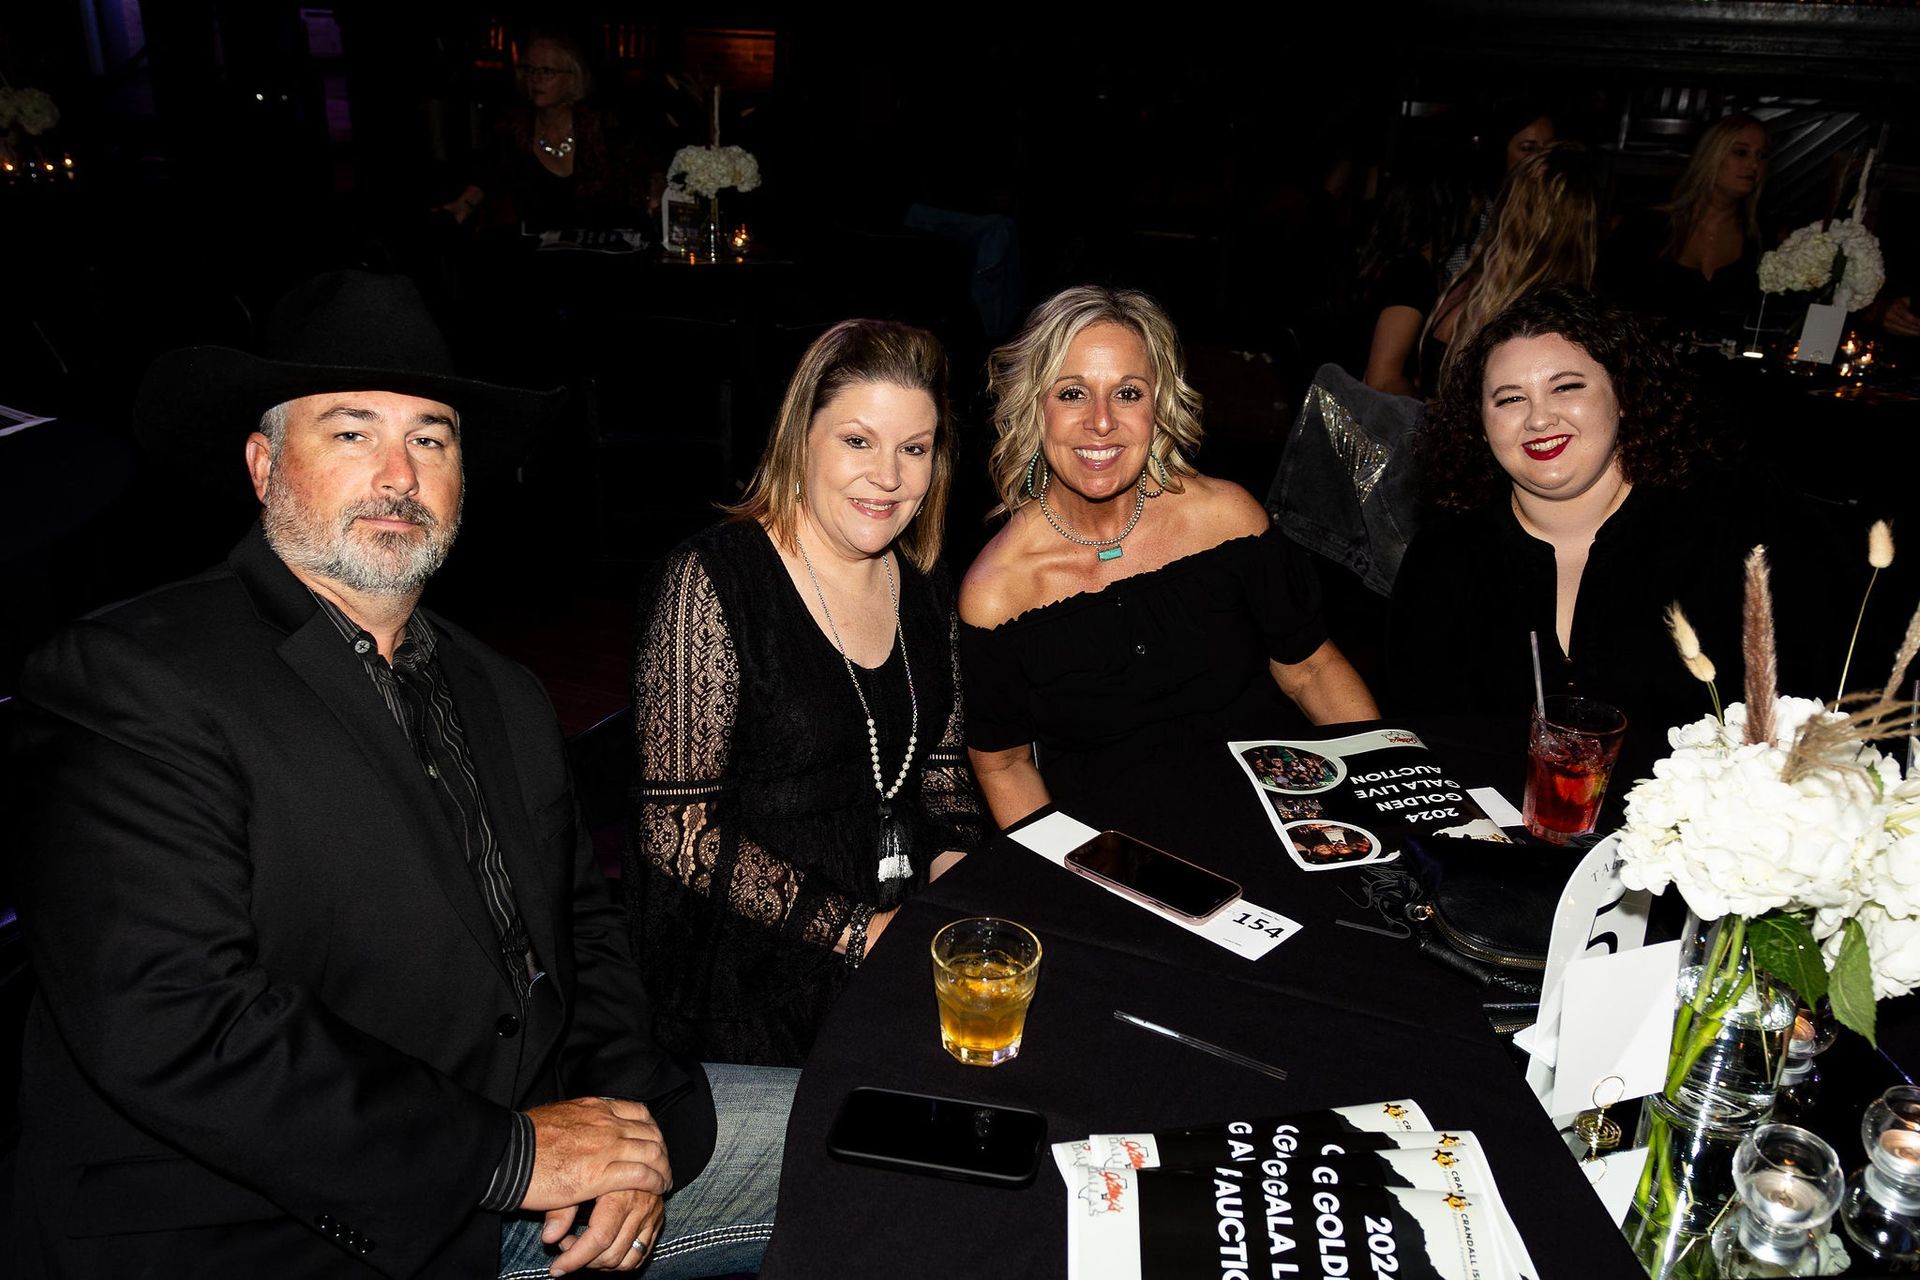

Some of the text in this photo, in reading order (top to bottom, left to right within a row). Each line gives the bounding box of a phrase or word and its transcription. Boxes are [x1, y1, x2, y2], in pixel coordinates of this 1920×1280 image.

[1349, 765, 1441, 784] AUCTION
[1354, 779, 1461, 799] GALA LIVE
[1375, 793, 1463, 812] GOLDEN
[1405, 807, 1460, 823] 2024
[1232, 912, 1285, 938] 154
[1262, 1179, 1296, 1255] GALA
[1312, 1191, 1350, 1280] GOLD
[1461, 1213, 1477, 1266] CRANDALL
